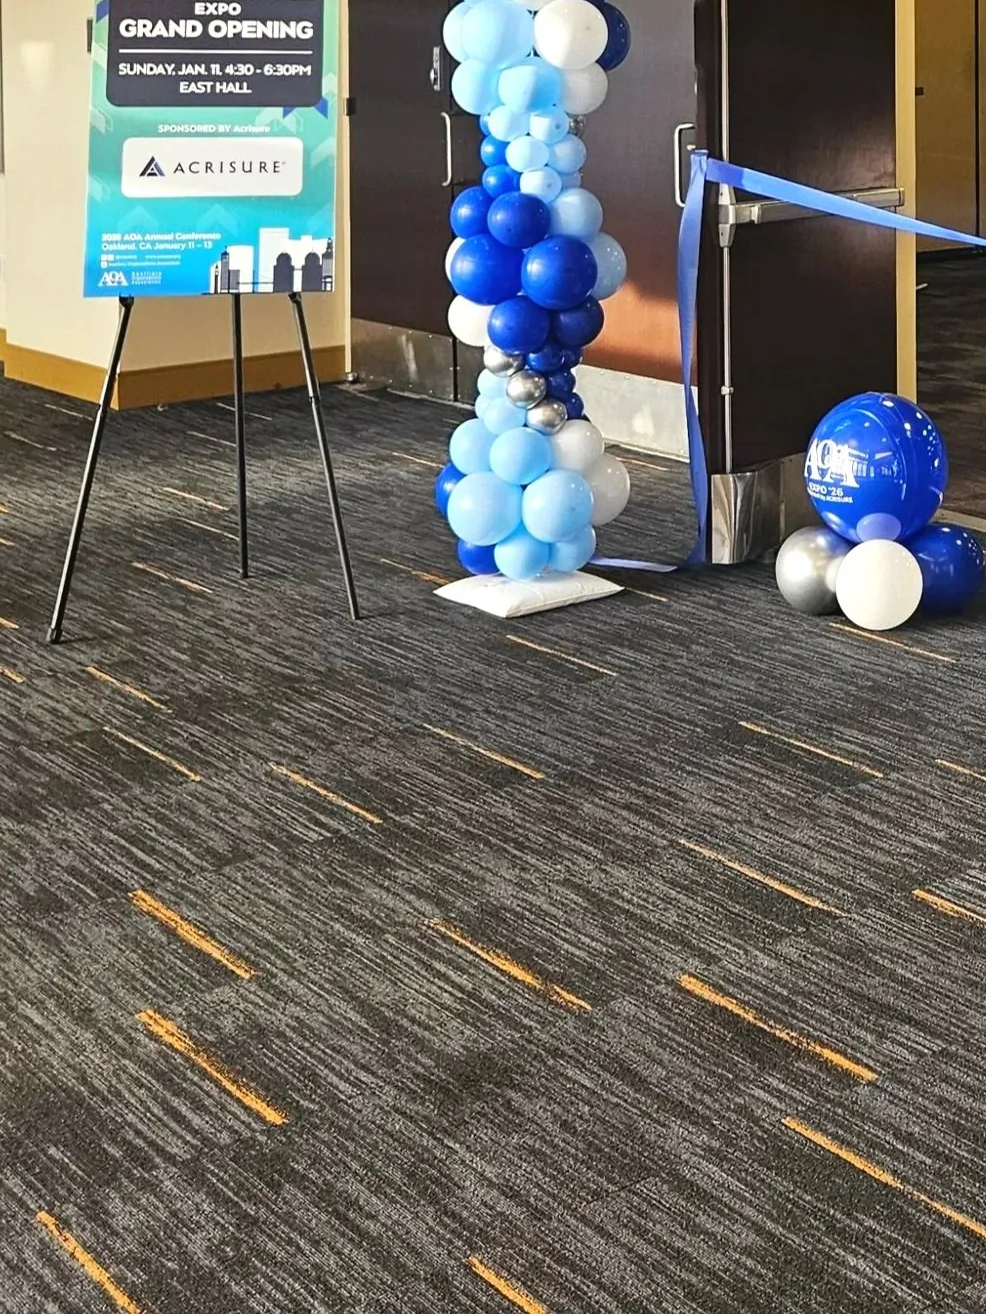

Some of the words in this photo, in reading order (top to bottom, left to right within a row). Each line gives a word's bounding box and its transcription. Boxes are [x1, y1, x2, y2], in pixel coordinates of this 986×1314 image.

[194, 2, 242, 16] EXPO
[119, 19, 203, 38] GRAND
[208, 21, 314, 39] OPENING
[177, 63, 208, 75] JAN.
[225, 64, 254, 76] 4:30
[263, 64, 312, 77] 6:30PM
[179, 82, 213, 94] EAST
[215, 82, 252, 94] HALL
[158, 124, 216, 133] SPONSORED
[218, 124, 231, 133] BY
[98, 271, 129, 286] AOA
[804, 438, 860, 487] AOA
